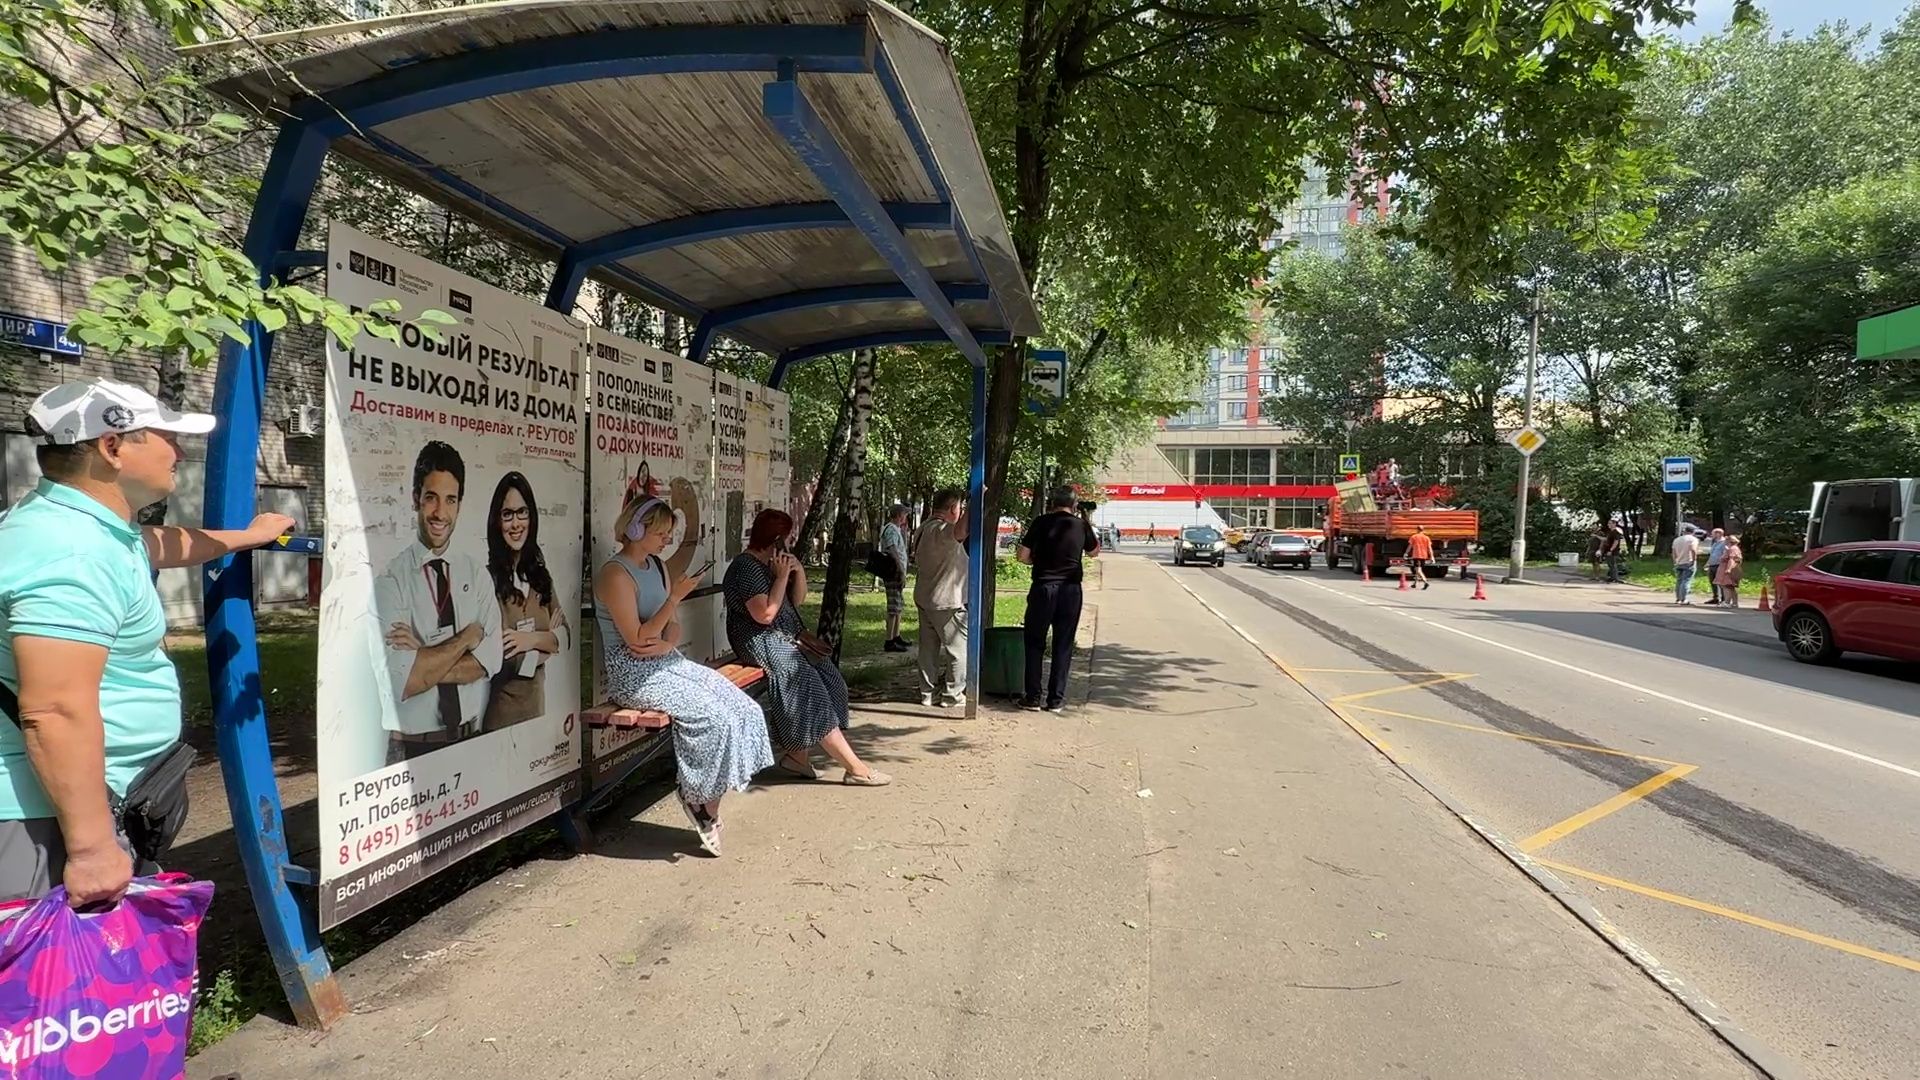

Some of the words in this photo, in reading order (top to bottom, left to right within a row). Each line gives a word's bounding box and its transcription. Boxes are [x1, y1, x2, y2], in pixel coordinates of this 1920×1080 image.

[350, 305, 472, 363] ОВЫЙ
[479, 344, 579, 392] РЕЗУЛЬТАТ
[349, 351, 384, 384] НЕ
[391, 362, 489, 407] ВЫХОДЯ
[495, 387, 519, 412] ИЗ
[524, 394, 577, 425] ДОМА
[598, 371, 673, 404] ПОПОЛНЕНИЕ
[598, 392, 604, 407] В
[350, 390, 435, 422] Доставим
[439, 412, 447, 425] в
[452, 413, 514, 437] пределах
[517, 425, 525, 438] г.
[528, 424, 575, 446] РЕУТОВ
[597, 413, 678, 441] ПОЗАБОТИМСЯ
[524, 445, 549, 456] услуга
[597, 435, 606, 451] О
[609, 437, 684, 460] ДОКУМЕНТАХ!
[339, 792, 349, 808] г.
[354, 770, 415, 801] Реутов,
[339, 817, 364, 841] ул.
[368, 789, 435, 825] Победы,
[436, 782, 450, 800] д.
[454, 772, 462, 790] 7
[339, 845, 349, 866] 8
[356, 823, 400, 862] (495)
[405, 789, 479, 836] 526-41-30
[336, 877, 366, 902] ВСЯ
[369, 834, 453, 887] ИНФОРМАЦИЯ
[454, 829, 469, 845] НА
[471, 810, 503, 835] САЙТЕ
